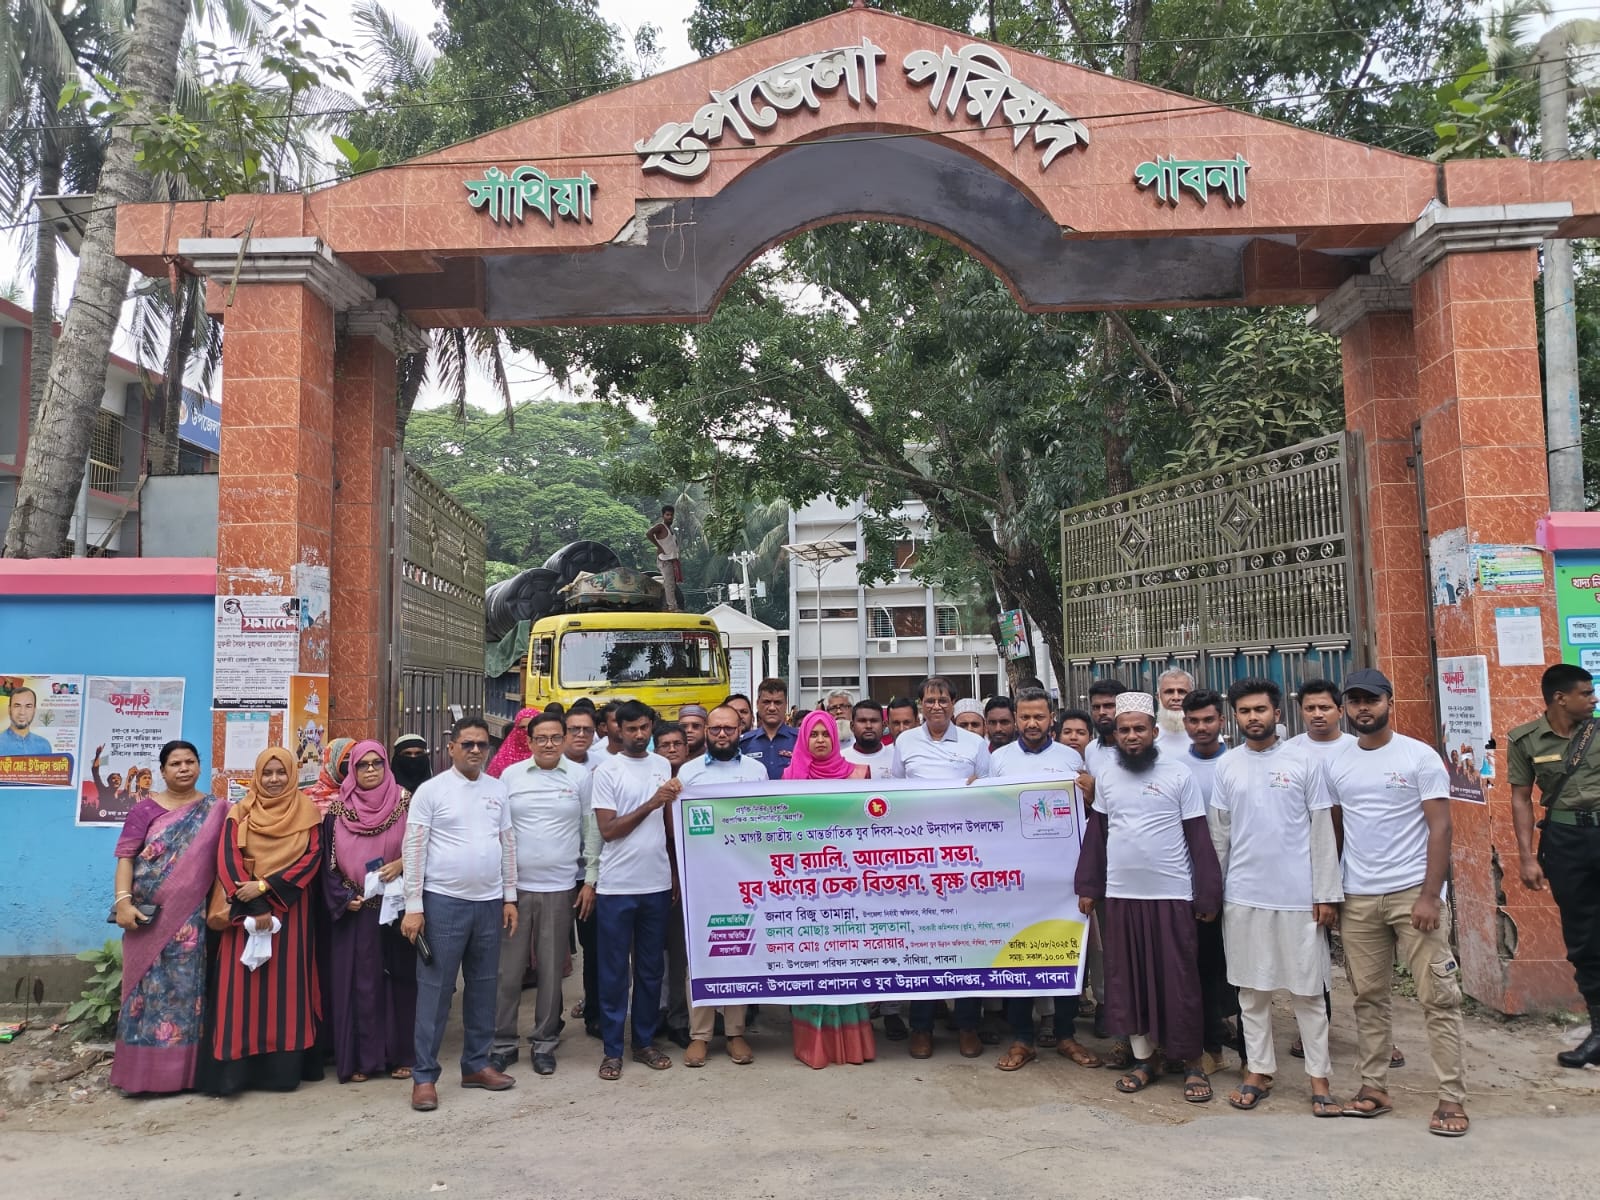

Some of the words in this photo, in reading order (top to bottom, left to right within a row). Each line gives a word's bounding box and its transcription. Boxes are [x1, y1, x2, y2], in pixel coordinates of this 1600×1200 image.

[634, 37, 886, 178] উপজেলা
[903, 43, 1089, 170] পরিষদ
[1134, 153, 1251, 206] পাবনা
[463, 167, 599, 226] সাঁথিয়া
[109, 688, 150, 715] জুলাই
[723, 833, 737, 846] ১২
[765, 827, 793, 843] জাতীয়
[796, 831, 803, 841] ও
[806, 824, 853, 840] আন্তর্জাতিক
[856, 826, 869, 841] যুব
[871, 823, 923, 840] দিবস-২০২৫
[770, 853, 795, 878] যুব
[853, 847, 935, 867] আলোচনা
[939, 844, 980, 864] সভা,
[738, 880, 763, 905] যুব
[767, 877, 817, 896] ঋণের
[822, 876, 858, 894] চেক
[862, 869, 926, 892] বিতরণ,
[929, 872, 965, 897] বৃক্ষ
[970, 869, 1022, 890] রোপণ
[764, 910, 792, 922] জনাব
[796, 906, 817, 923] রিজু
[821, 907, 859, 921] তামান্না,
[765, 926, 794, 938] জনাব
[833, 922, 866, 935] সাদিয়া
[869, 920, 915, 936] সুলতানা,
[766, 942, 795, 954] জনাব
[798, 941, 820, 954] মোঃ
[823, 939, 859, 952] গোলাম
[786, 959, 820, 970] উপজেলা
[822, 957, 848, 969] পরিষদ
[903, 953, 932, 967] সাঁথিয়া,
[704, 981, 764, 996] আয়োজনে:
[766, 978, 814, 993] উপজেলা
[817, 977, 857, 992] প্রশাসন
[862, 978, 872, 989] ও
[875, 975, 892, 992] যুব
[895, 973, 930, 990] উন্নয়ন
[932, 971, 986, 988] অধিদপ্তর,
[988, 969, 1032, 987] সাঁথিয়া,
